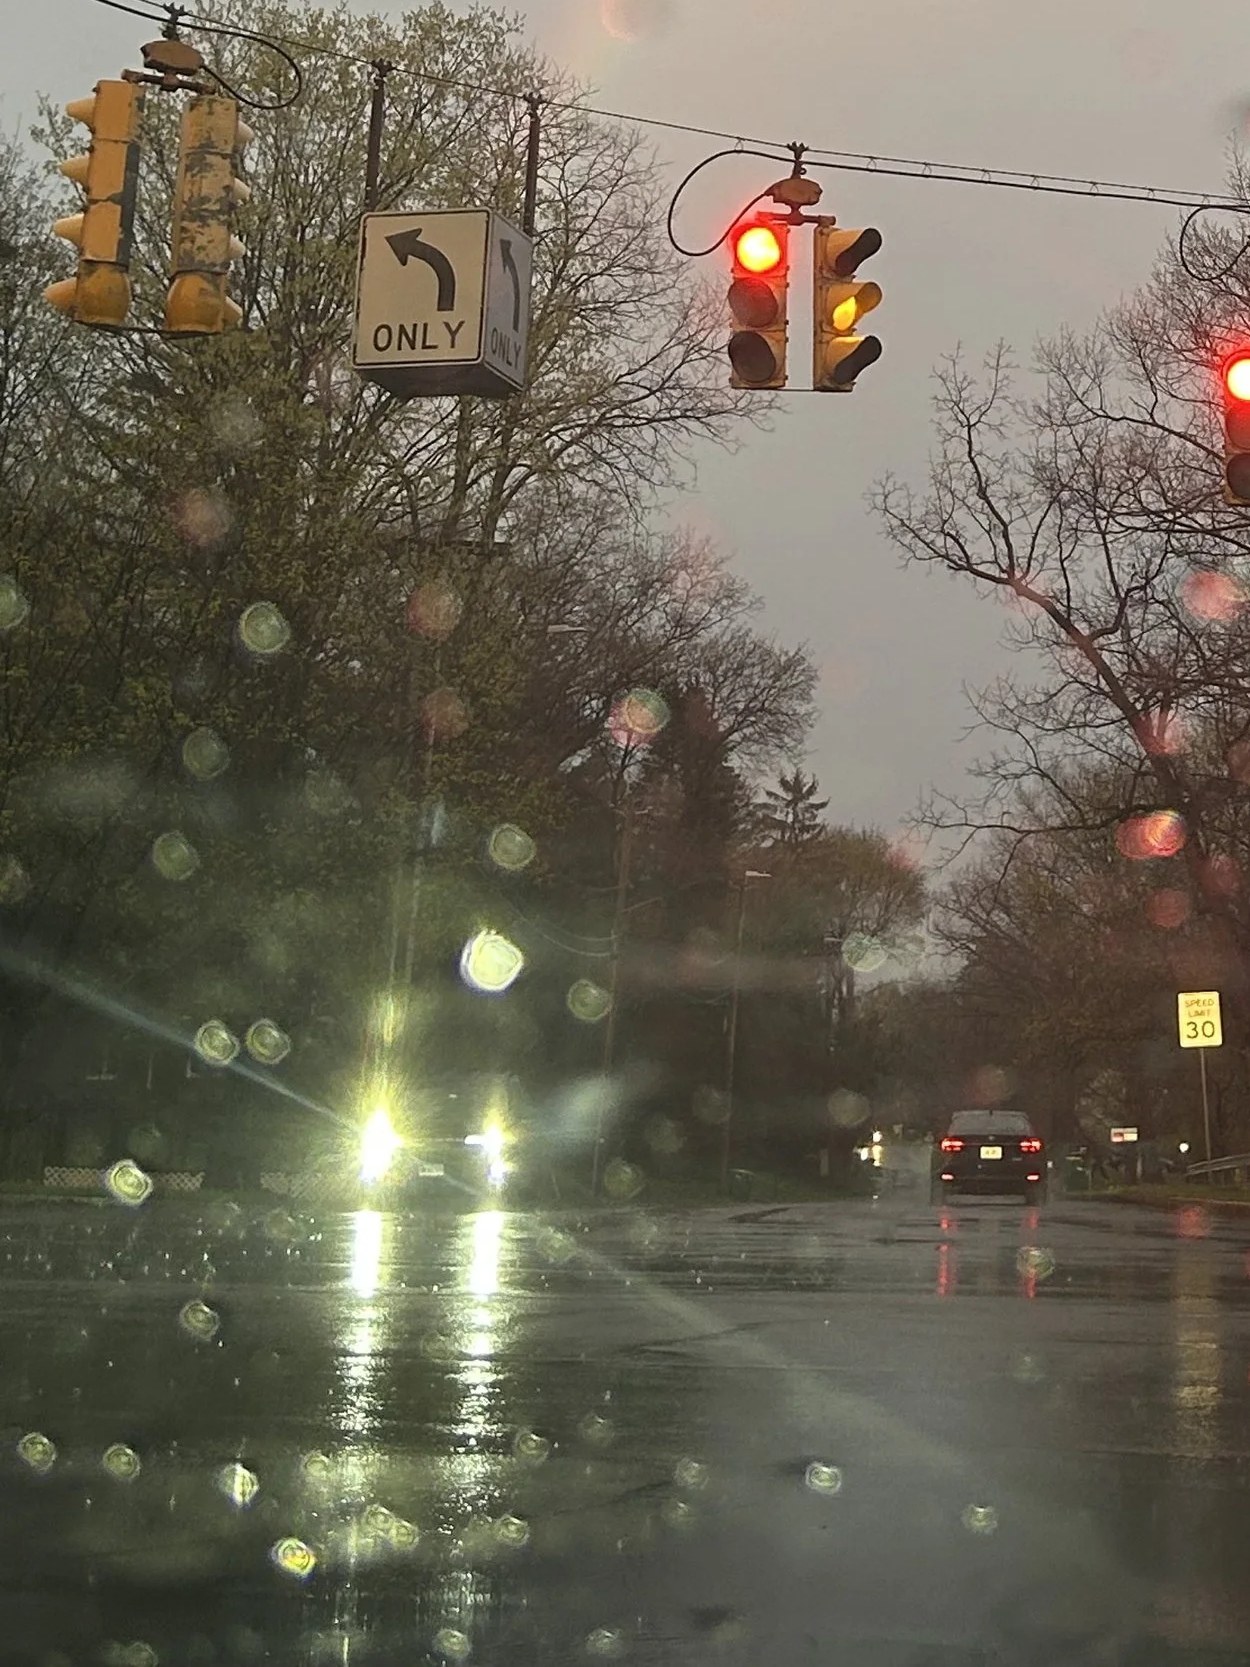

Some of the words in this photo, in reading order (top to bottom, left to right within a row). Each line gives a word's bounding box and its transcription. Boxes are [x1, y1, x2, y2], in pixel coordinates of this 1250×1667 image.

[373, 320, 466, 352] ONLY
[490, 327, 522, 370] ONLY
[1186, 1020, 1216, 1040] 30
